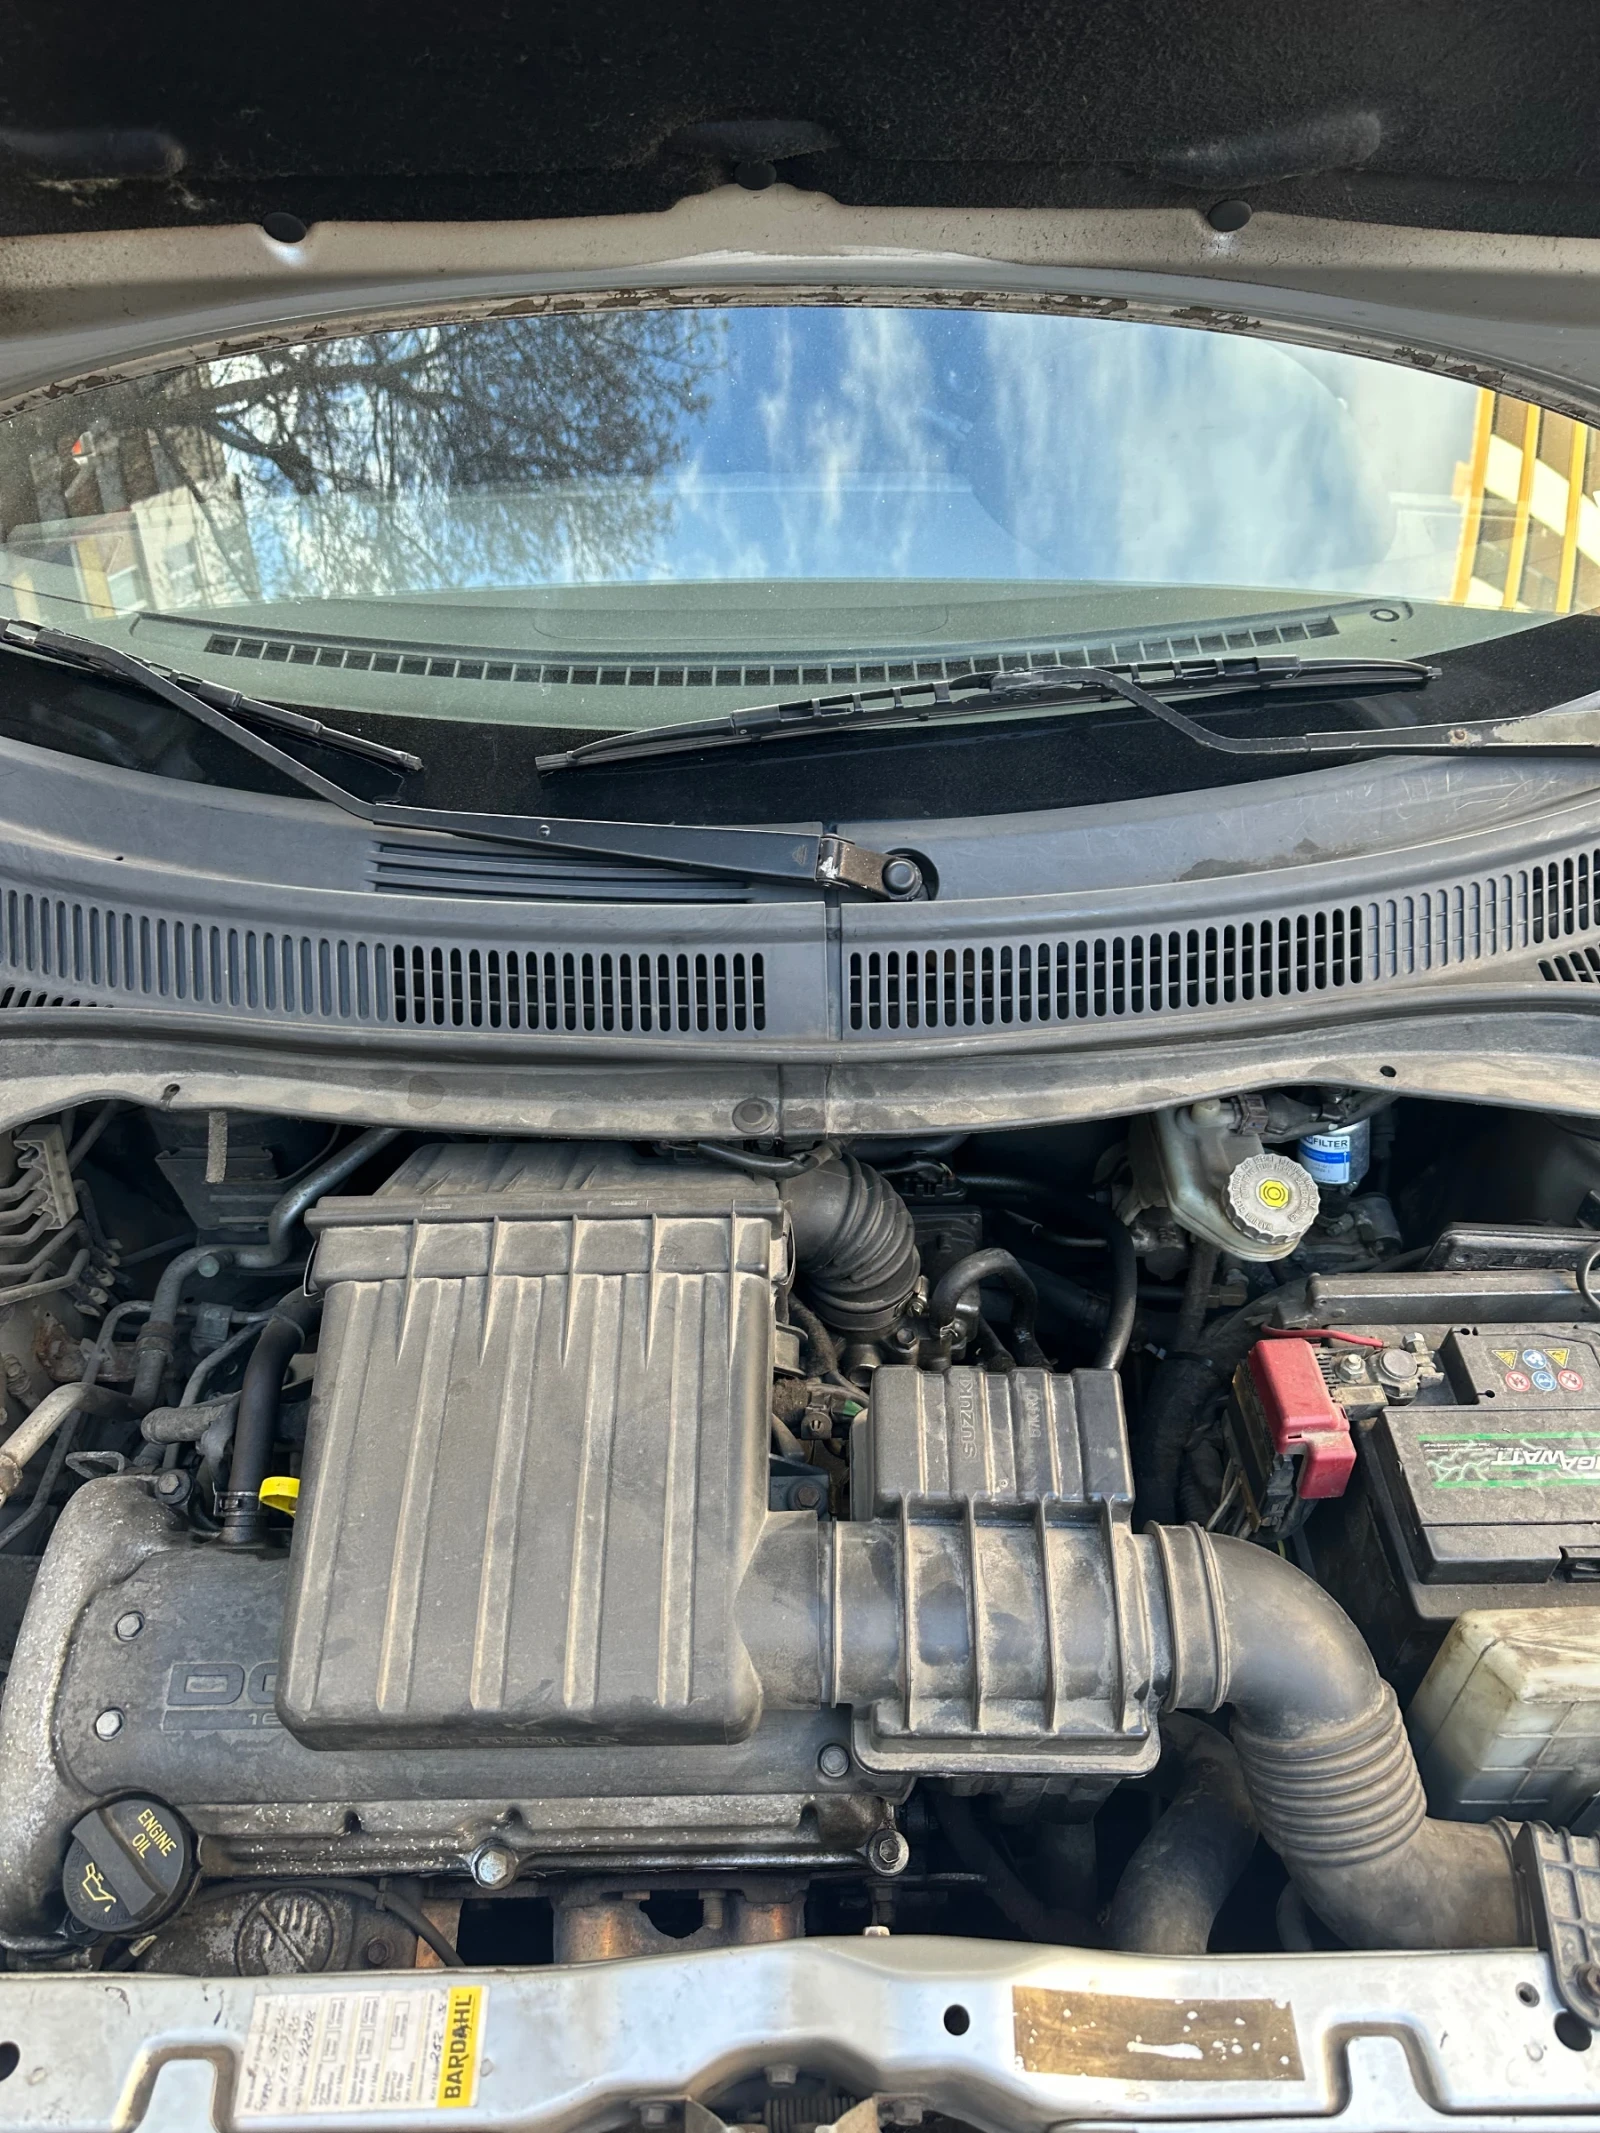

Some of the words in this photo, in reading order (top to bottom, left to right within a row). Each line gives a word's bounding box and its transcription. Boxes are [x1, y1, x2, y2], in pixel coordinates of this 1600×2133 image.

[1313, 1138, 1348, 1148] FILTER
[958, 1376, 977, 1459] SUZUKI
[132, 1833, 152, 1859] OIL
[137, 1808, 177, 1858] ENGINE
[444, 1994, 472, 2099] BARDAHL
